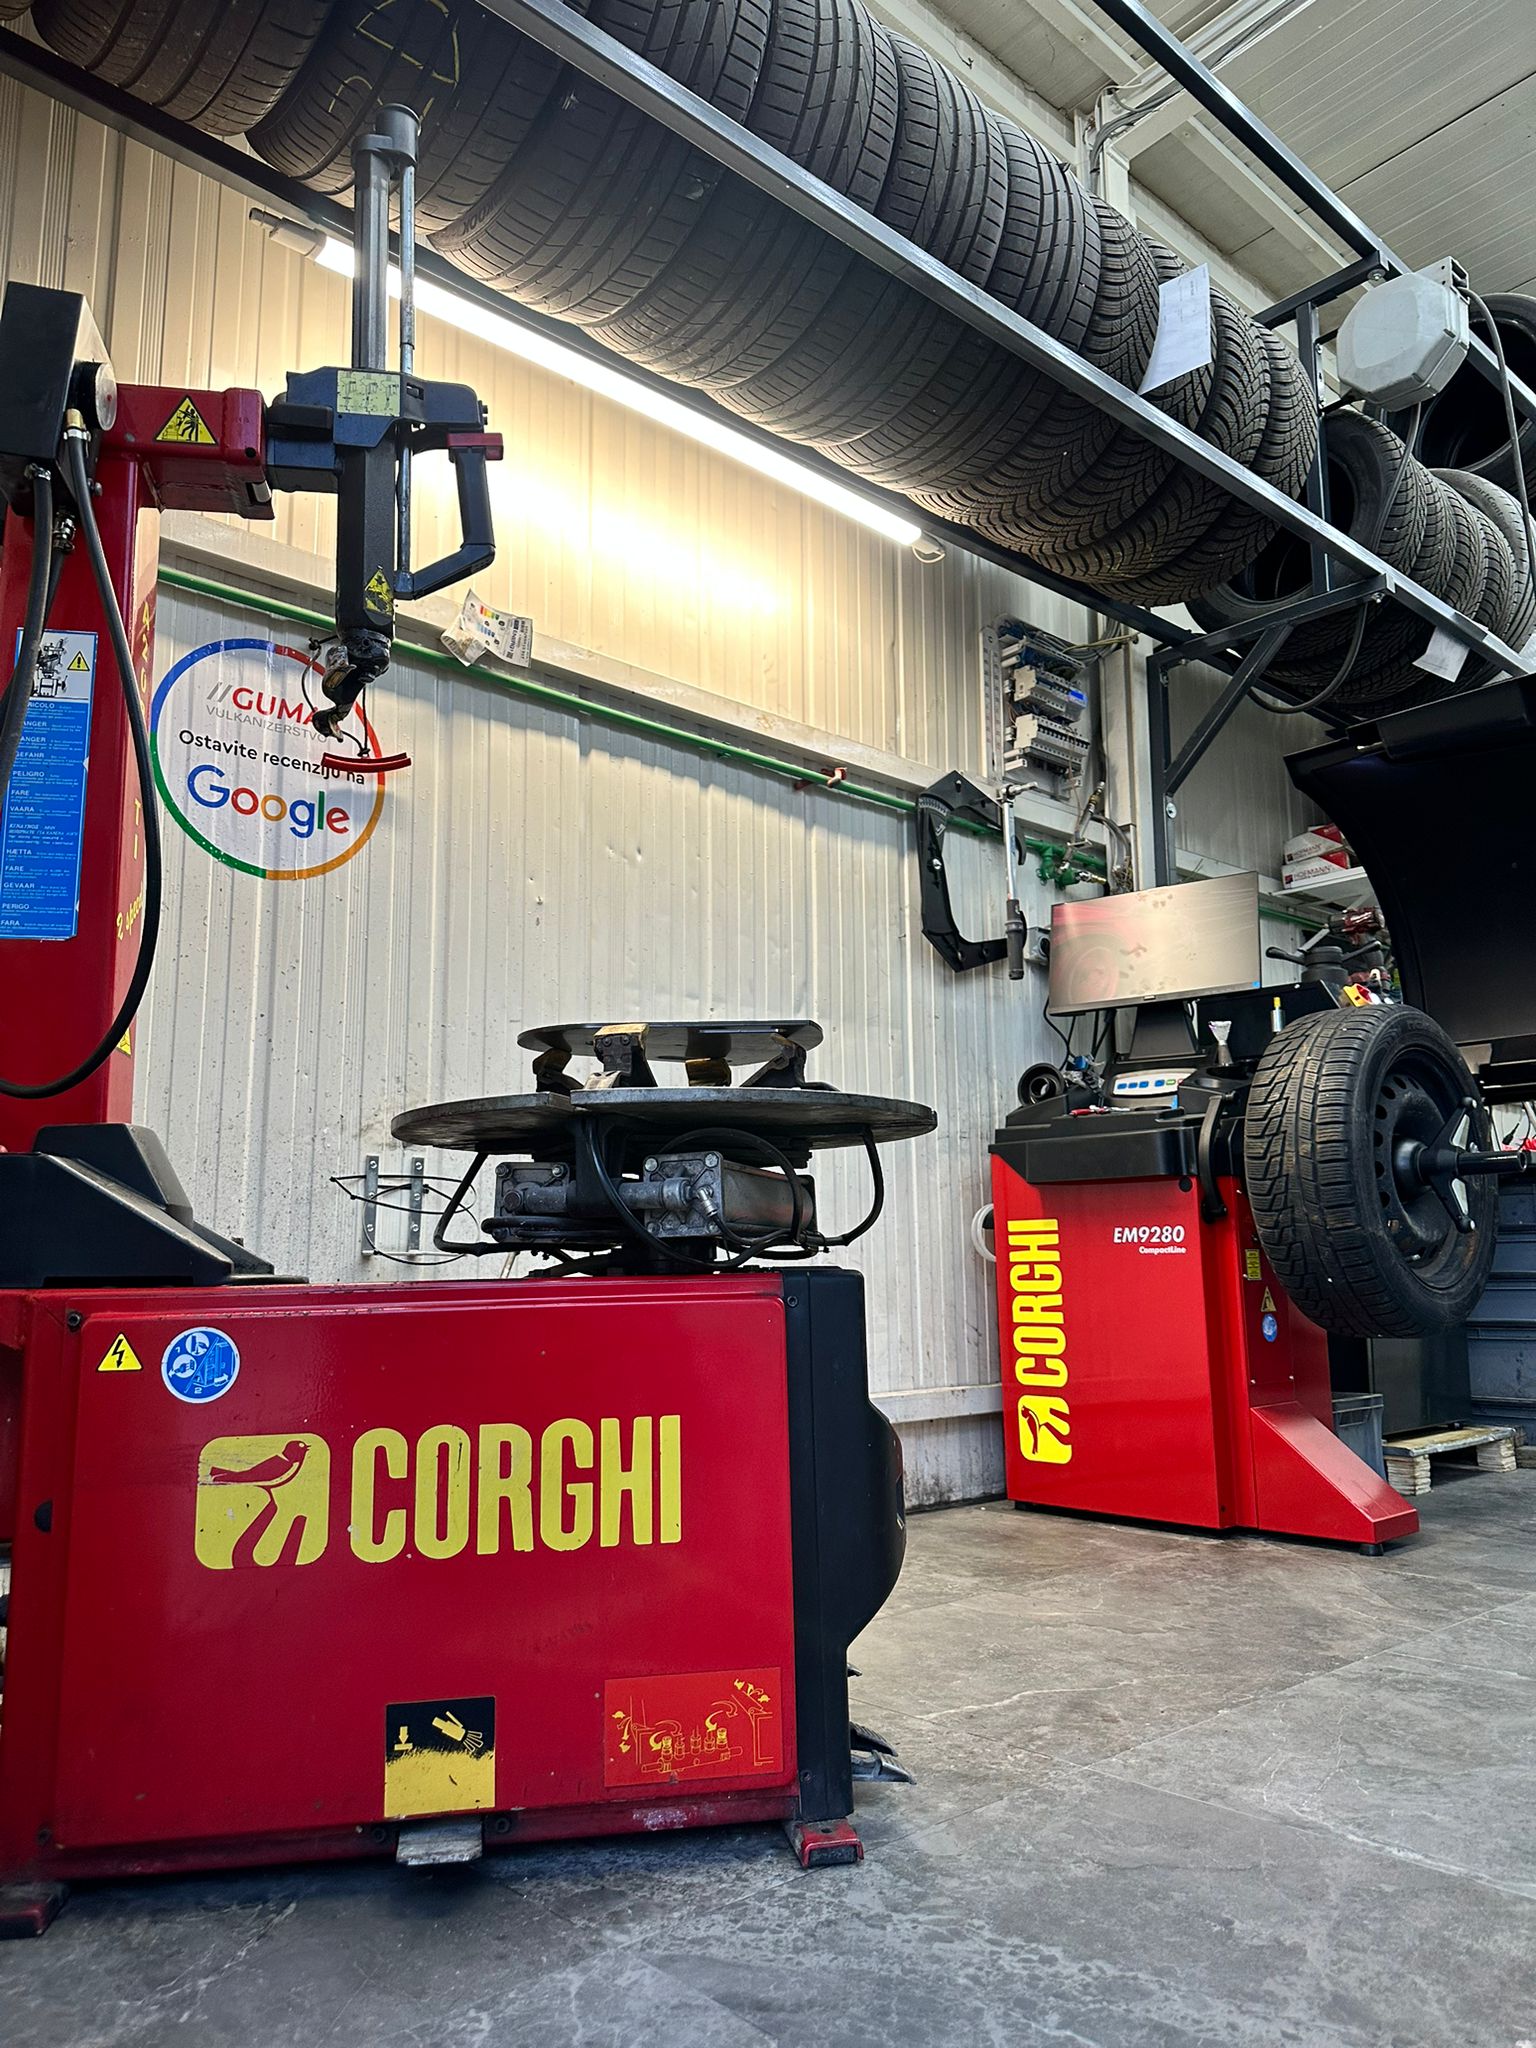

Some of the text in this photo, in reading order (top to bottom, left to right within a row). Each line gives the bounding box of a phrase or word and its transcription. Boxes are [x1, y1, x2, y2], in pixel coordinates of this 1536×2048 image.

[206, 704, 328, 743] VULKANIZERSTVO
[179, 729, 258, 759] Ostavite
[12, 770, 45, 778] PELIGRO
[187, 764, 350, 839] Google
[1113, 1225, 1185, 1243] EM9280
[1139, 1246, 1186, 1255] CompactLine
[1008, 1219, 1068, 1388] CORGHI
[350, 1415, 682, 1563] CORGHI
